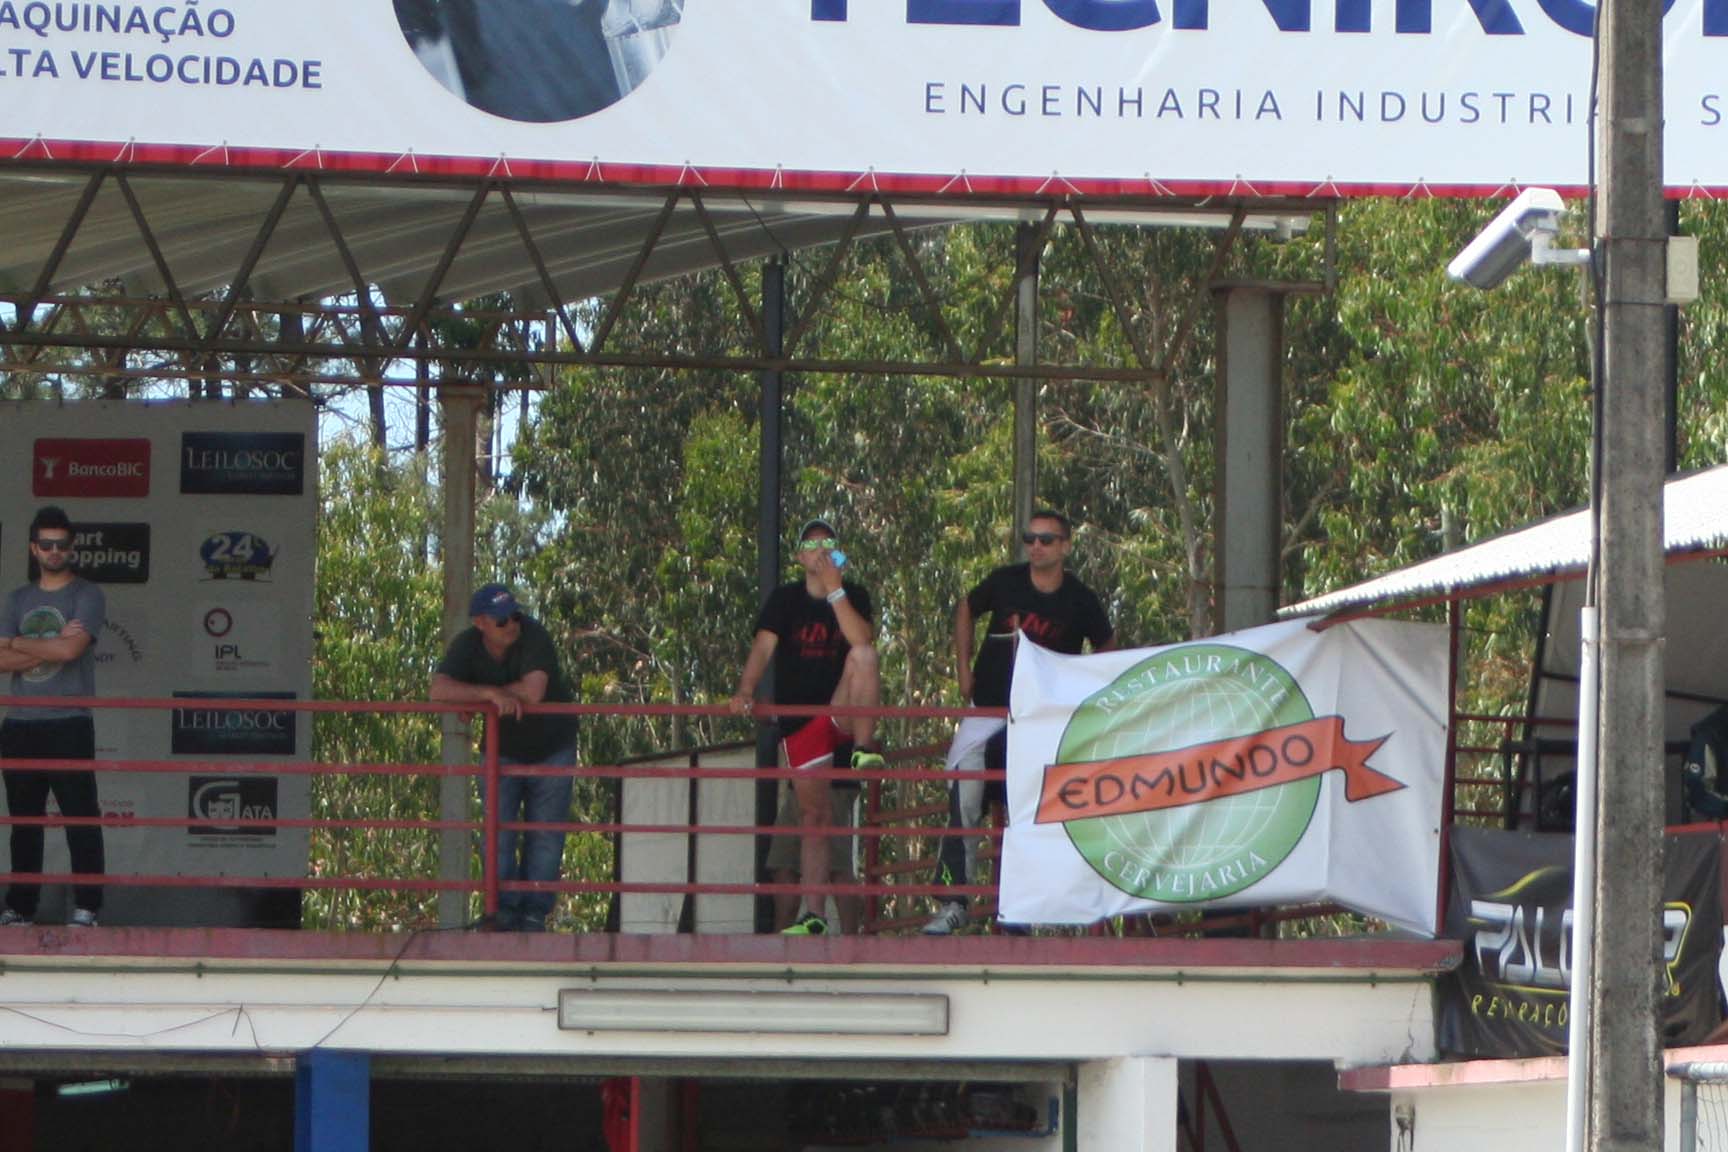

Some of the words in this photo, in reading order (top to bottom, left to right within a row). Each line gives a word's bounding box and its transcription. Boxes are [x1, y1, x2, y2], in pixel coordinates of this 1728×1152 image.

[70, 50, 323, 89] VELOCIDADE
[924, 82, 1282, 120] ENGENHARIA
[1317, 90, 1602, 126] INDUSTRI
[68, 461, 144, 478] BancoBIC
[185, 447, 297, 471] LEILOSOC
[211, 533, 255, 561] 24
[215, 644, 242, 660] IPL
[1057, 734, 1314, 809] EDMUNDO
[1103, 849, 1270, 894] CERVEJARIA
